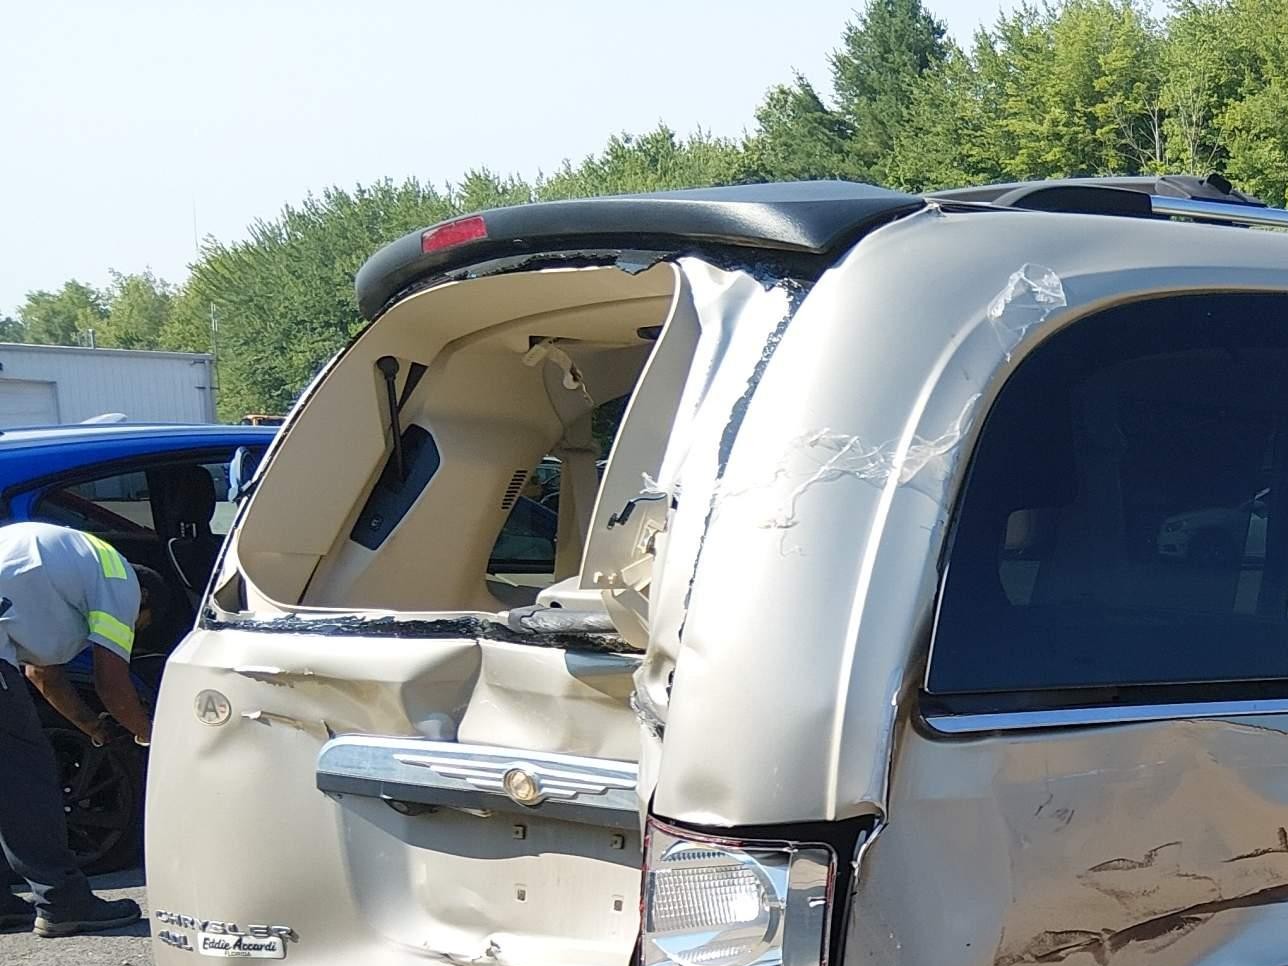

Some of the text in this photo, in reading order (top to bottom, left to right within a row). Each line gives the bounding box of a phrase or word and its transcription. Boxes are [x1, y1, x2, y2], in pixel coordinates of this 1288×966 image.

[155, 909, 299, 943] CHRYSLER
[203, 936, 277, 952] Eddie Accardi
